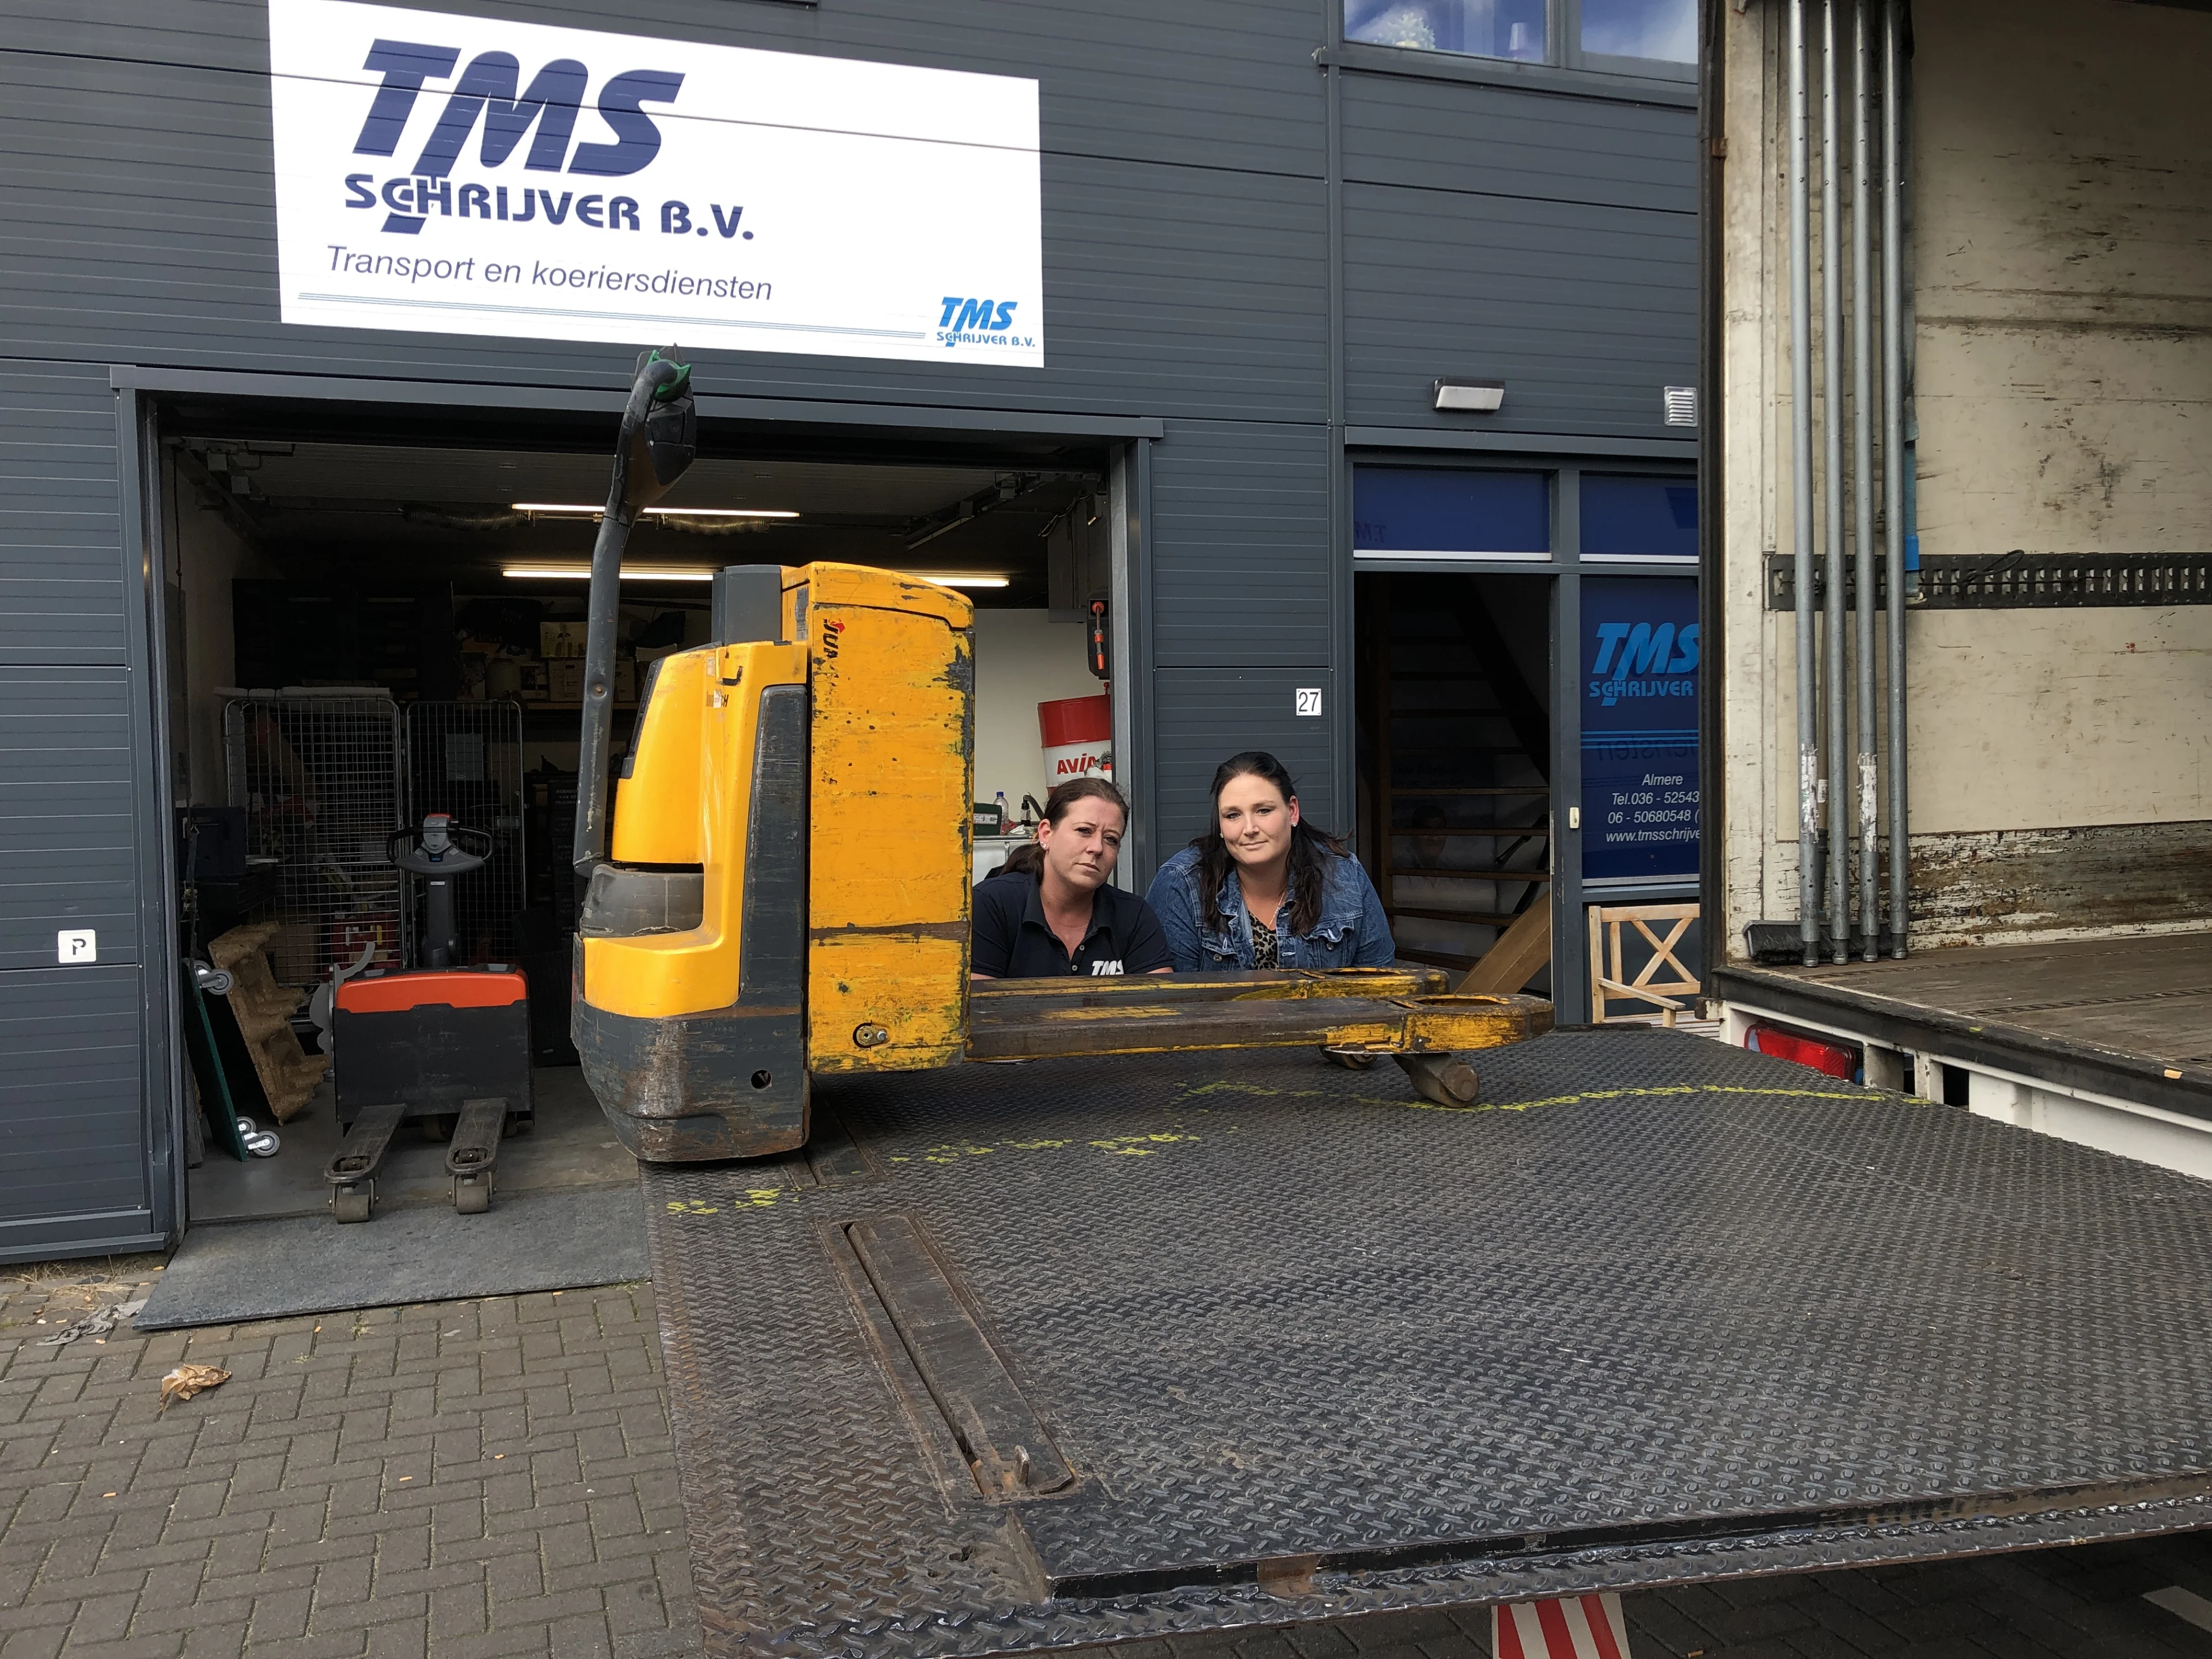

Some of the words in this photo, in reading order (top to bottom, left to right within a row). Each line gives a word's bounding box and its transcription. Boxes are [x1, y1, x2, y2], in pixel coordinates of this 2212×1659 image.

[352, 38, 686, 179] TMS
[344, 173, 640, 232] SCHRIJVER
[661, 200, 754, 240] B.V.
[327, 245, 475, 283] Transport
[484, 262, 521, 283] en
[532, 260, 772, 300] koeriersdiensten
[938, 296, 1018, 331] TMS
[936, 331, 1007, 346] SCHRIJVER
[1011, 336, 1036, 348] B.V.
[1592, 622, 1699, 680] TMS
[1589, 680, 1694, 698] SCHRIJVER
[1298, 692, 1319, 712] 27
[1641, 773, 1683, 786] Almere
[1612, 793, 1653, 805] Tel.036
[1664, 791, 1700, 804] 52543
[1608, 812, 1623, 824] 06
[1633, 809, 1692, 823] 50680548
[1092, 959, 1124, 976] TMS
